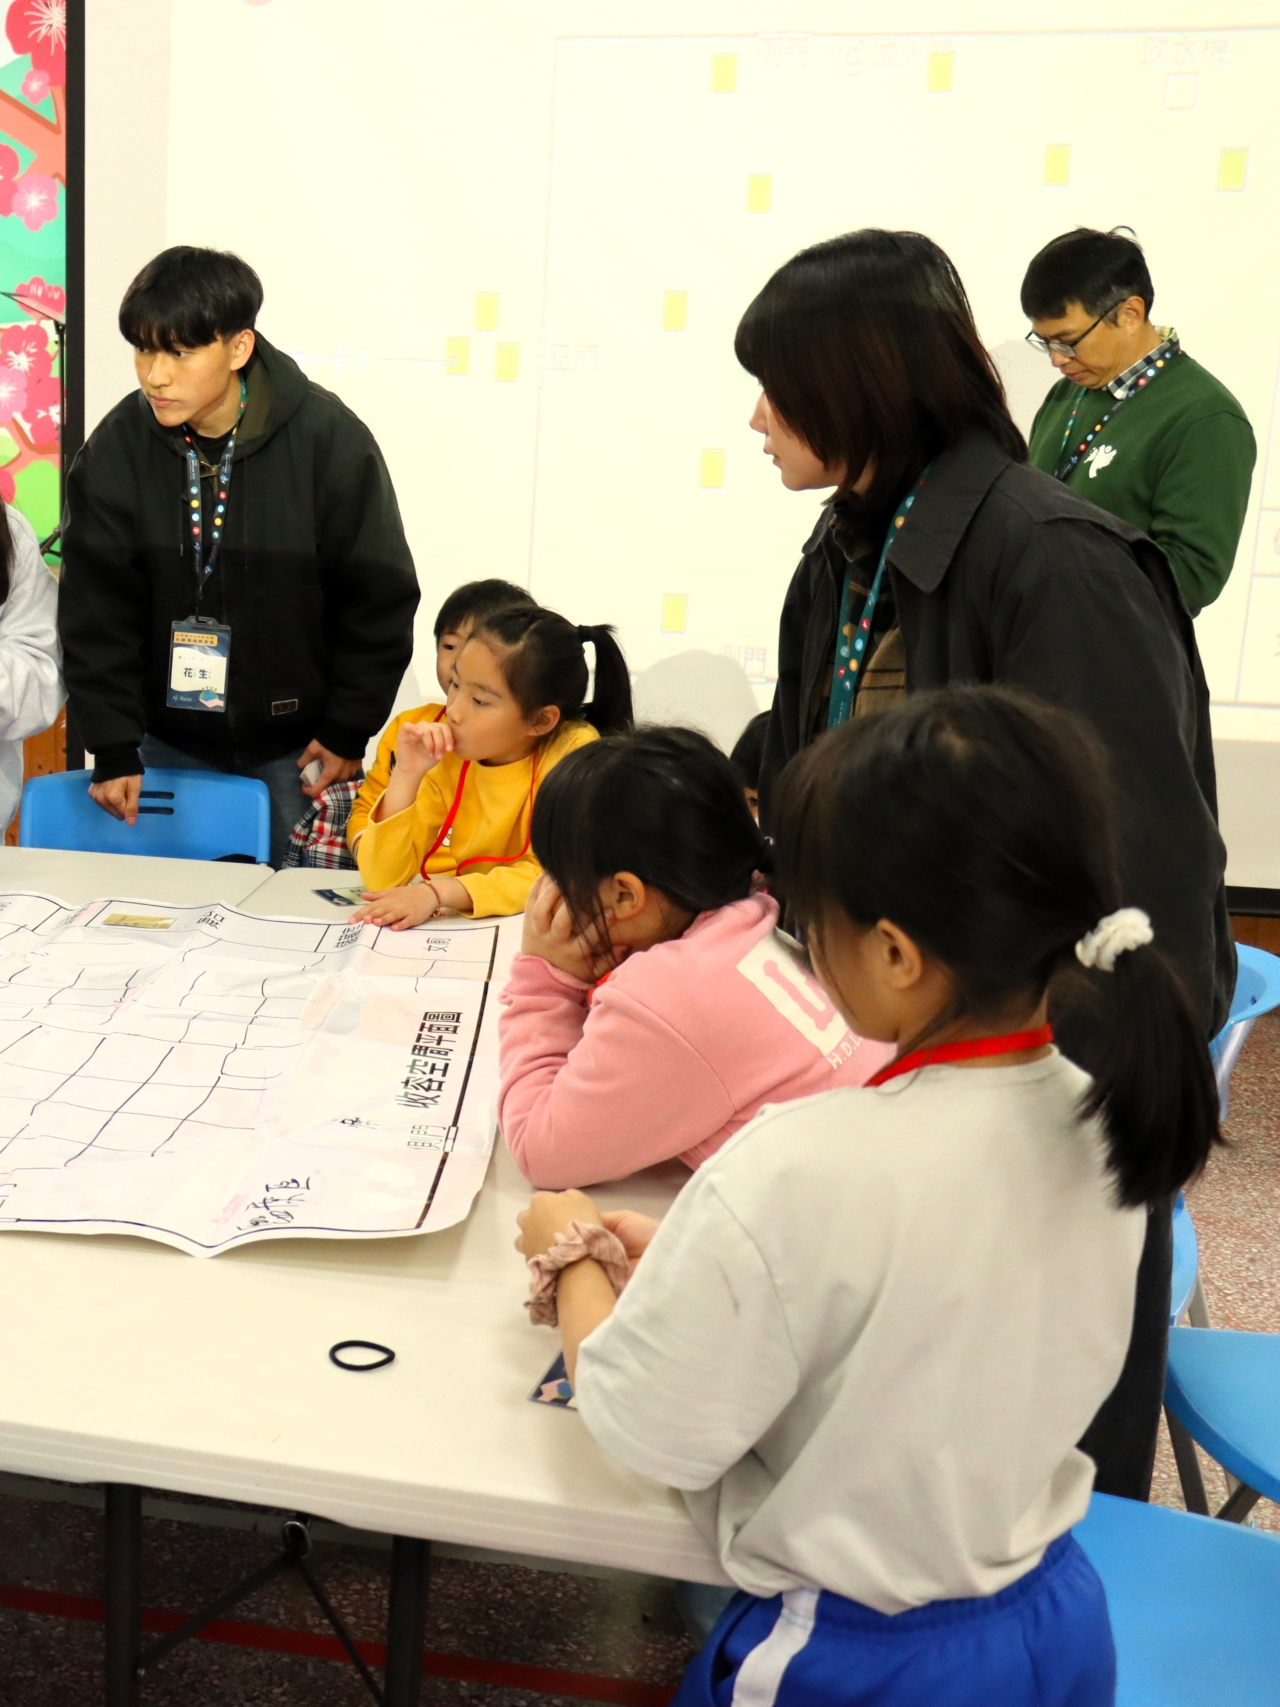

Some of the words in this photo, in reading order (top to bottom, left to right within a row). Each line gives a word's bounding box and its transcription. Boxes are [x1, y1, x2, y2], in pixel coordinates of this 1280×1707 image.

[395, 1011, 463, 1109] 收容空間平面圖
